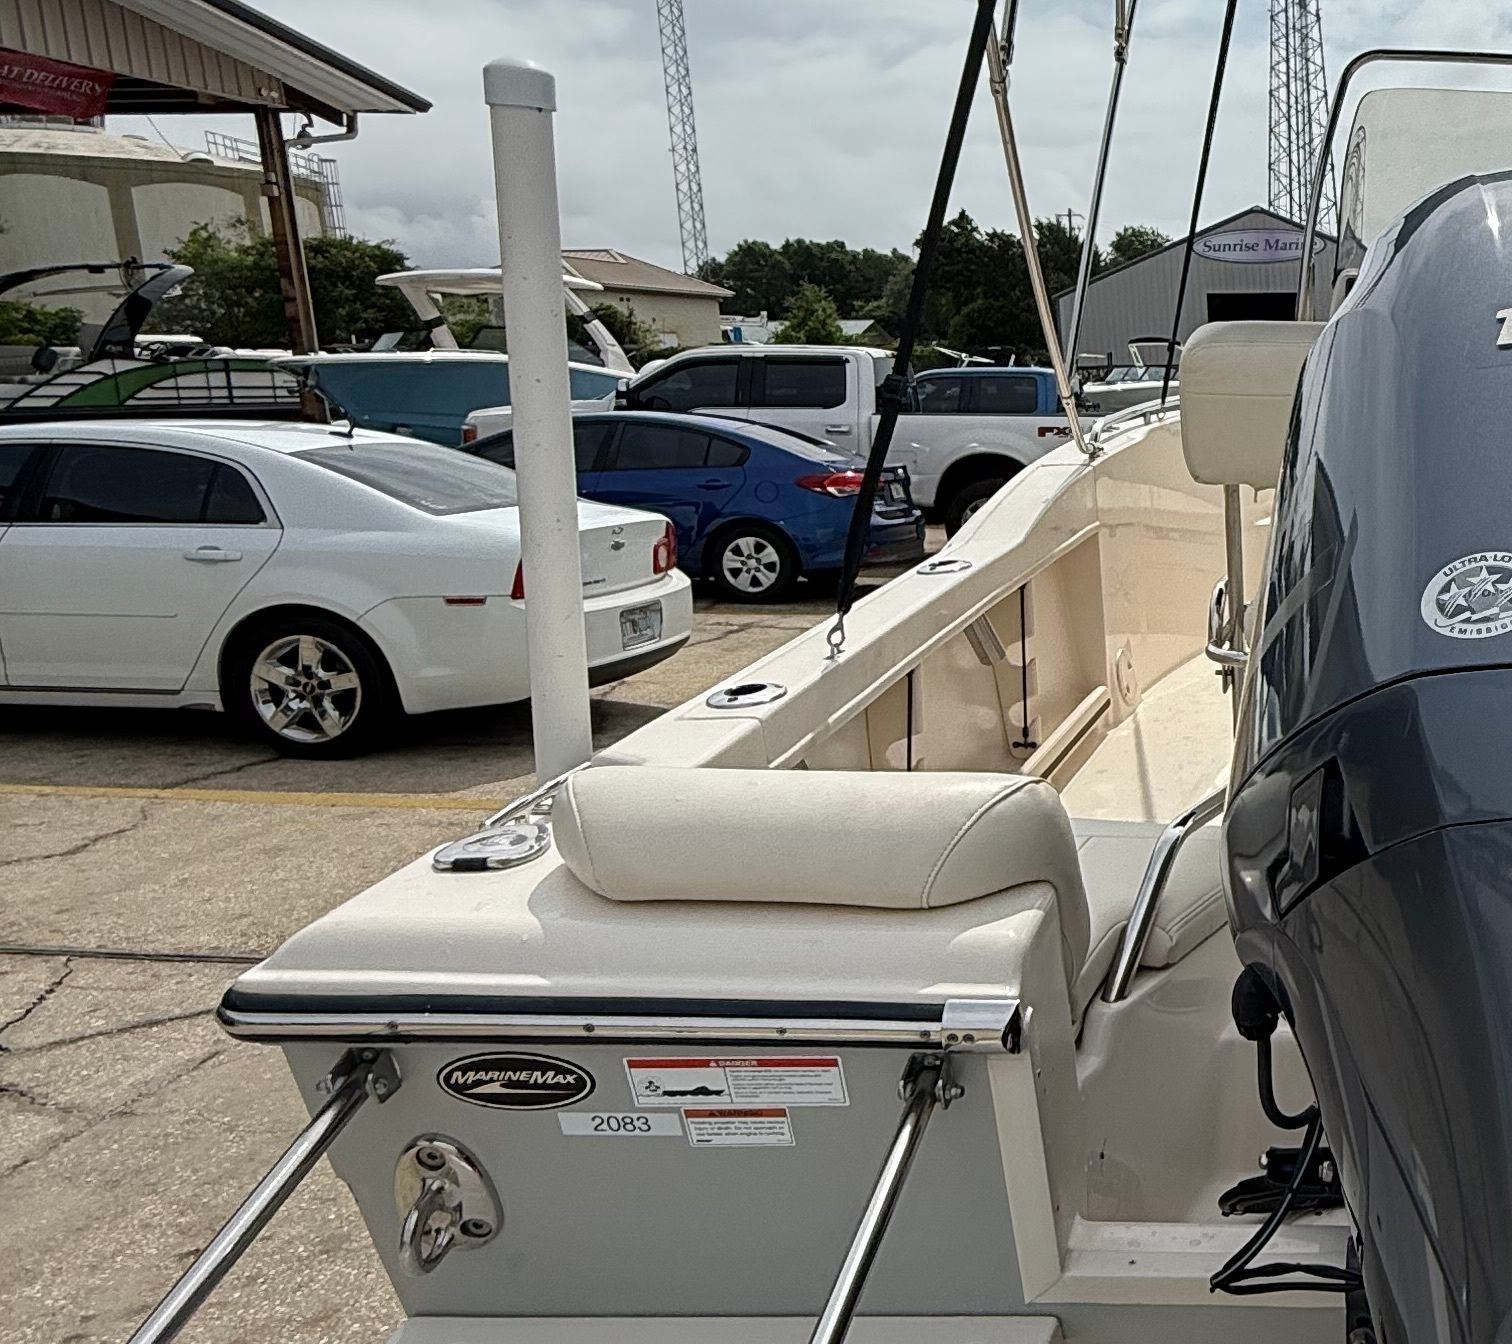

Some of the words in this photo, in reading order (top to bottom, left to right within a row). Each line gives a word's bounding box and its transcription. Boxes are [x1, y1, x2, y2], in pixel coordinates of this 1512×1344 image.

[22, 69, 103, 96] DELIVERY
[1203, 239, 1260, 253] Sunrise
[591, 1115, 652, 1133] 2083
